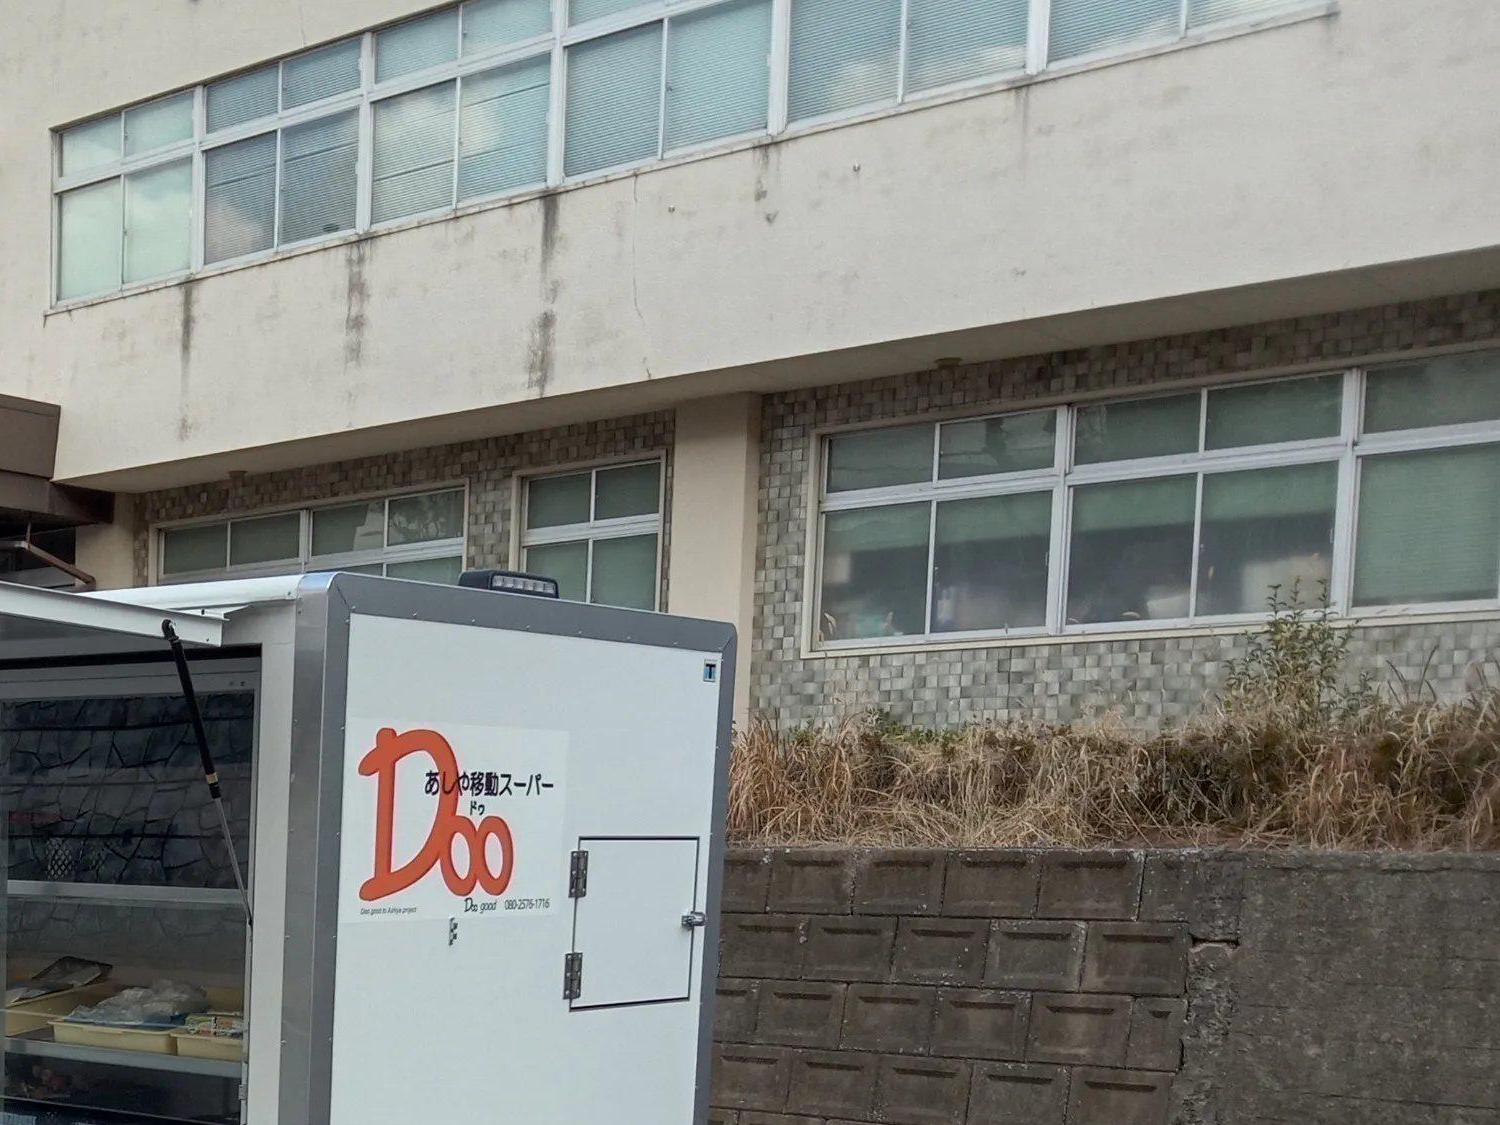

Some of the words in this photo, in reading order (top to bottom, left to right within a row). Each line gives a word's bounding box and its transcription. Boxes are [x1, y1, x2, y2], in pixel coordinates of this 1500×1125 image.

[424, 770, 554, 797] あしや移動スーパー
[358, 727, 514, 900] Doo
[480, 900, 498, 914] good
[504, 898, 550, 910] 080-2576-1716
